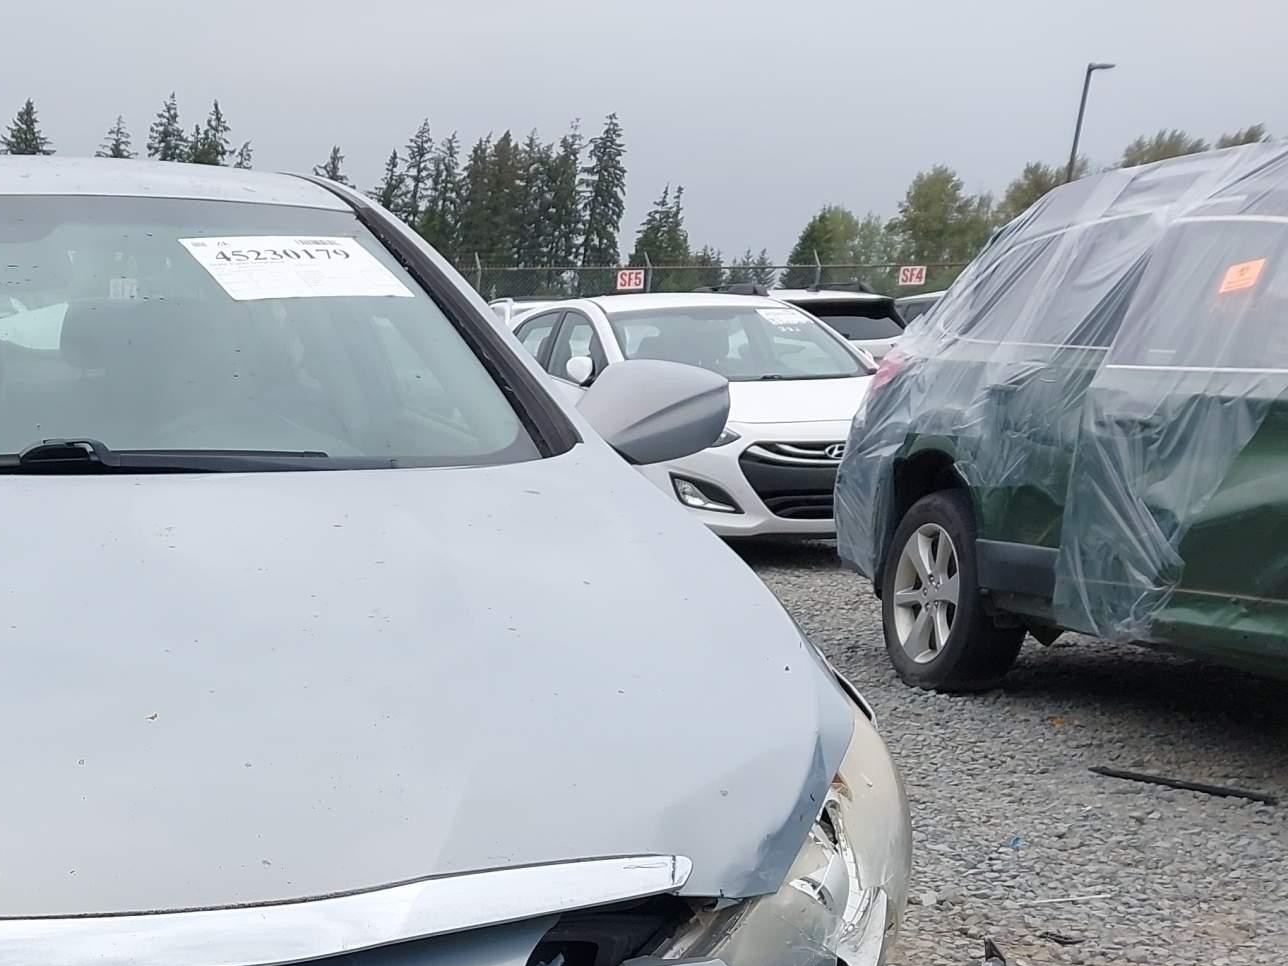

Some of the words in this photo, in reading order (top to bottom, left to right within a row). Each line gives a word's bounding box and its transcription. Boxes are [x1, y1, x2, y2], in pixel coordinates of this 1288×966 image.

[215, 249, 350, 262] 45230179
[619, 271, 642, 287] SF5
[902, 267, 924, 283] SF4
